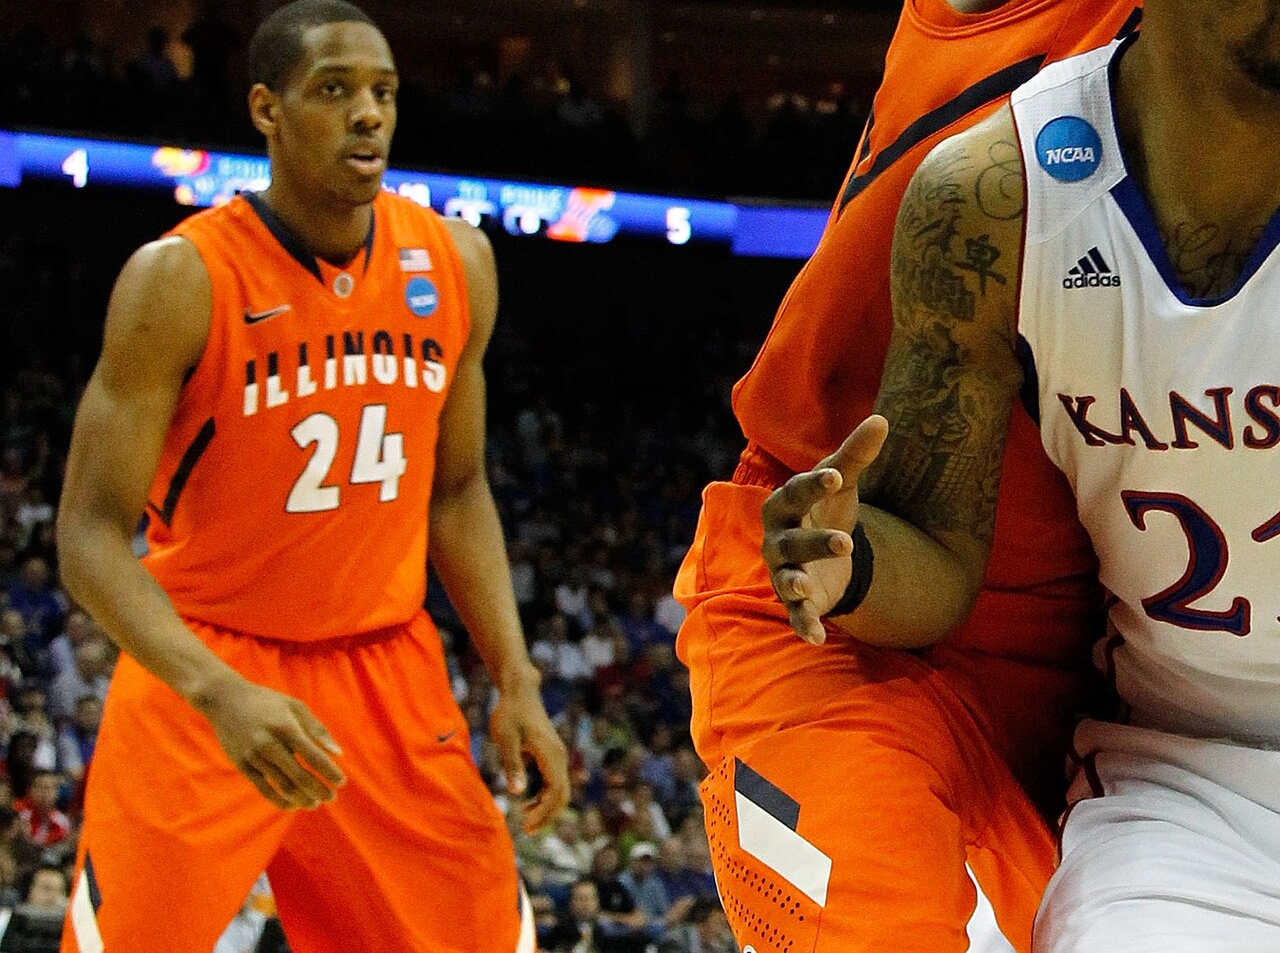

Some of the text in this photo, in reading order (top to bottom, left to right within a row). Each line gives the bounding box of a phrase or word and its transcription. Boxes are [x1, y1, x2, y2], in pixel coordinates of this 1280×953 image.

[62, 149, 89, 188] 4
[1046, 147, 1095, 165] NCAA
[665, 206, 692, 244] 5
[1062, 273, 1121, 289] adidas
[242, 329, 447, 417] ILLINOIS
[285, 403, 408, 514] 24
